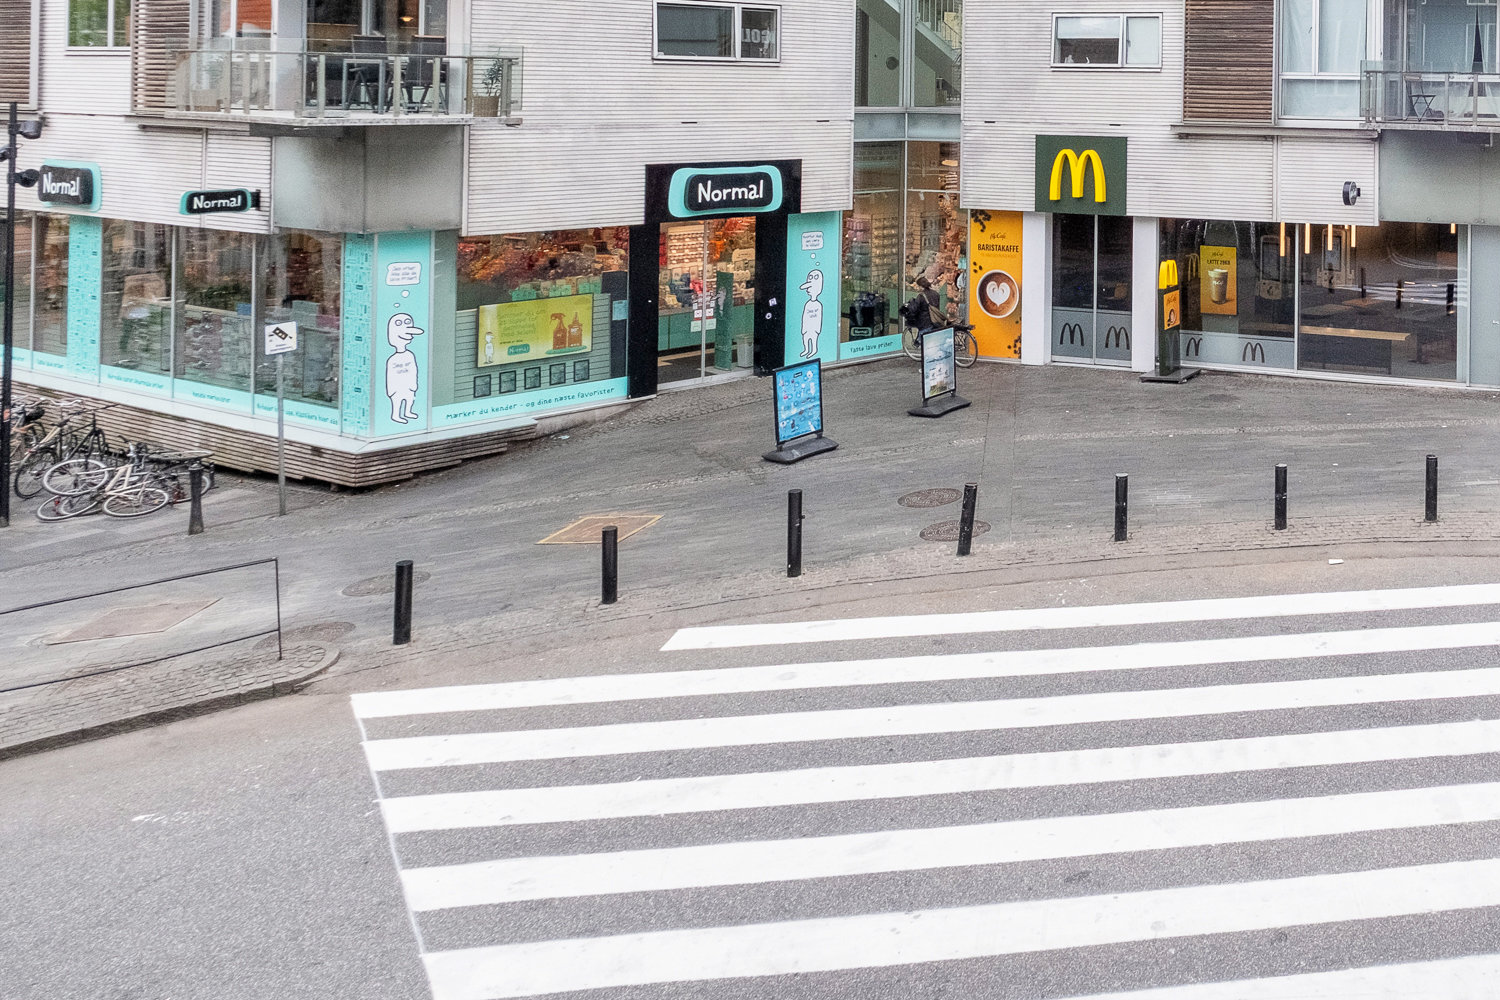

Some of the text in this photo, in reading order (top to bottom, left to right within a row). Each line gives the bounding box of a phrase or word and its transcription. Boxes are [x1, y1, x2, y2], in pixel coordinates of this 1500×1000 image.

[42, 172, 80, 196] Normal
[698, 180, 764, 203] Normal
[193, 195, 241, 209] Normal
[977, 244, 1019, 252] BARISTAKAFFE
[491, 403, 518, 412] kender
[537, 398, 552, 406] dine
